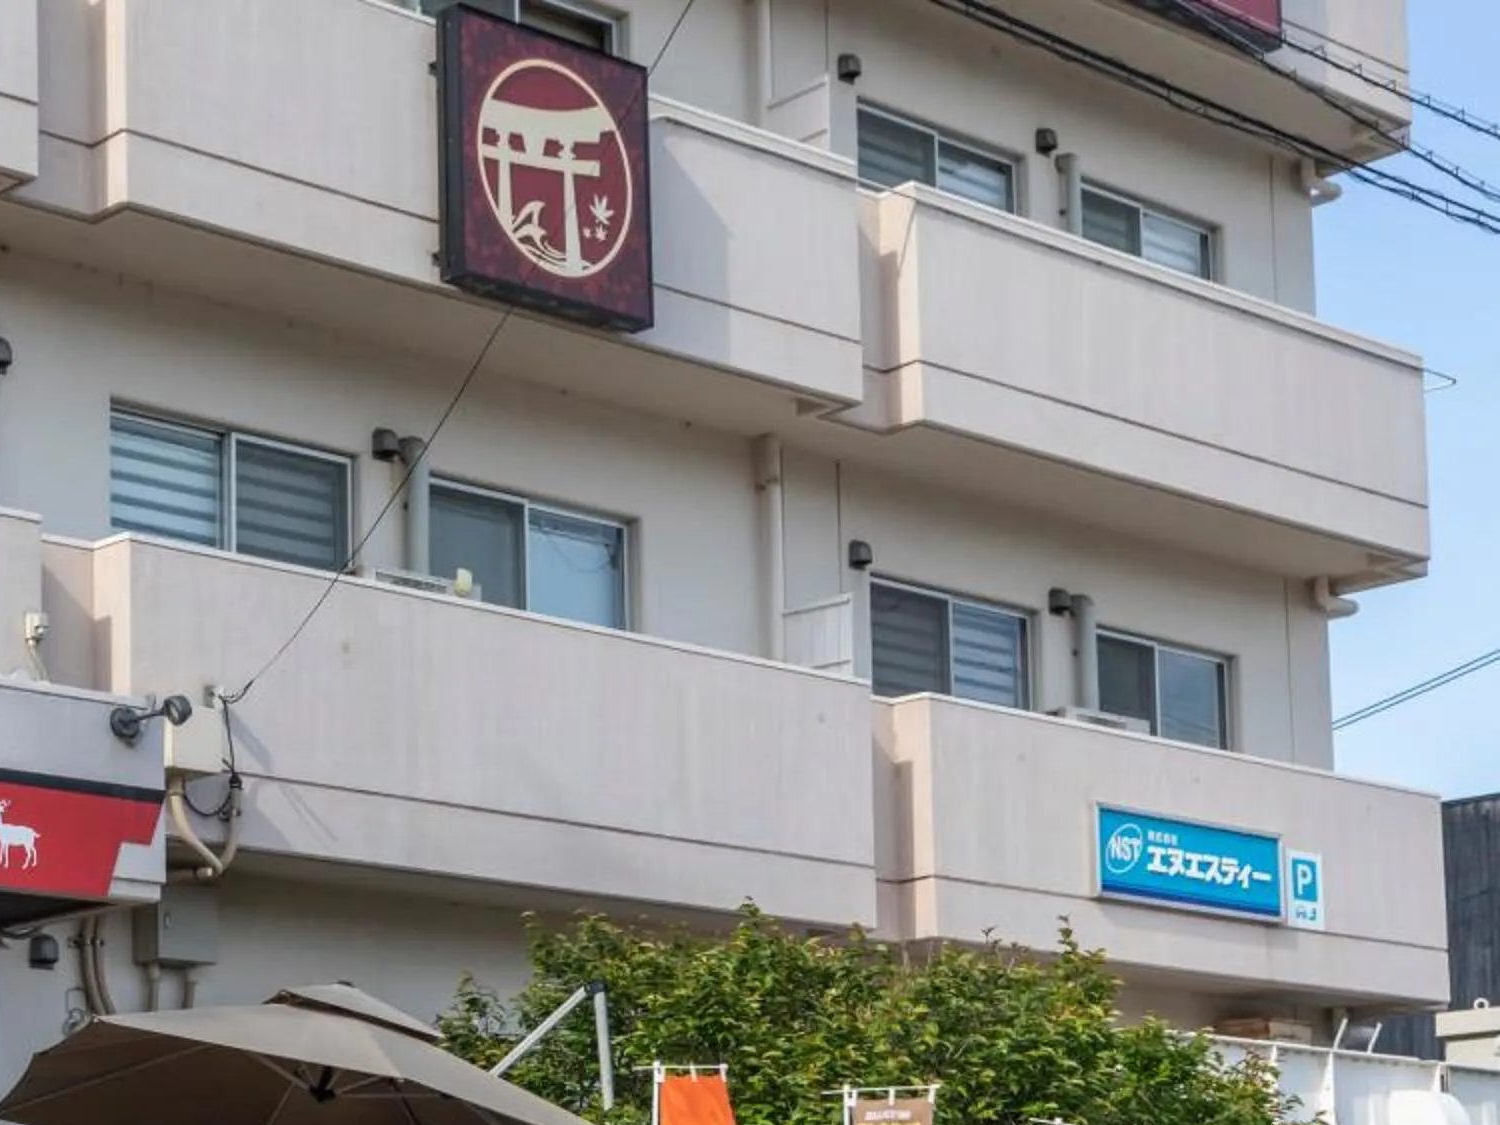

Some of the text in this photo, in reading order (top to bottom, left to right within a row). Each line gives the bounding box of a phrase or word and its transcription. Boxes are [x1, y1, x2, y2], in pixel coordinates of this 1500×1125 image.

[1109, 833, 1142, 862] NST
[1146, 845, 1273, 888] エヌエスティー
[1296, 863, 1313, 895] P
